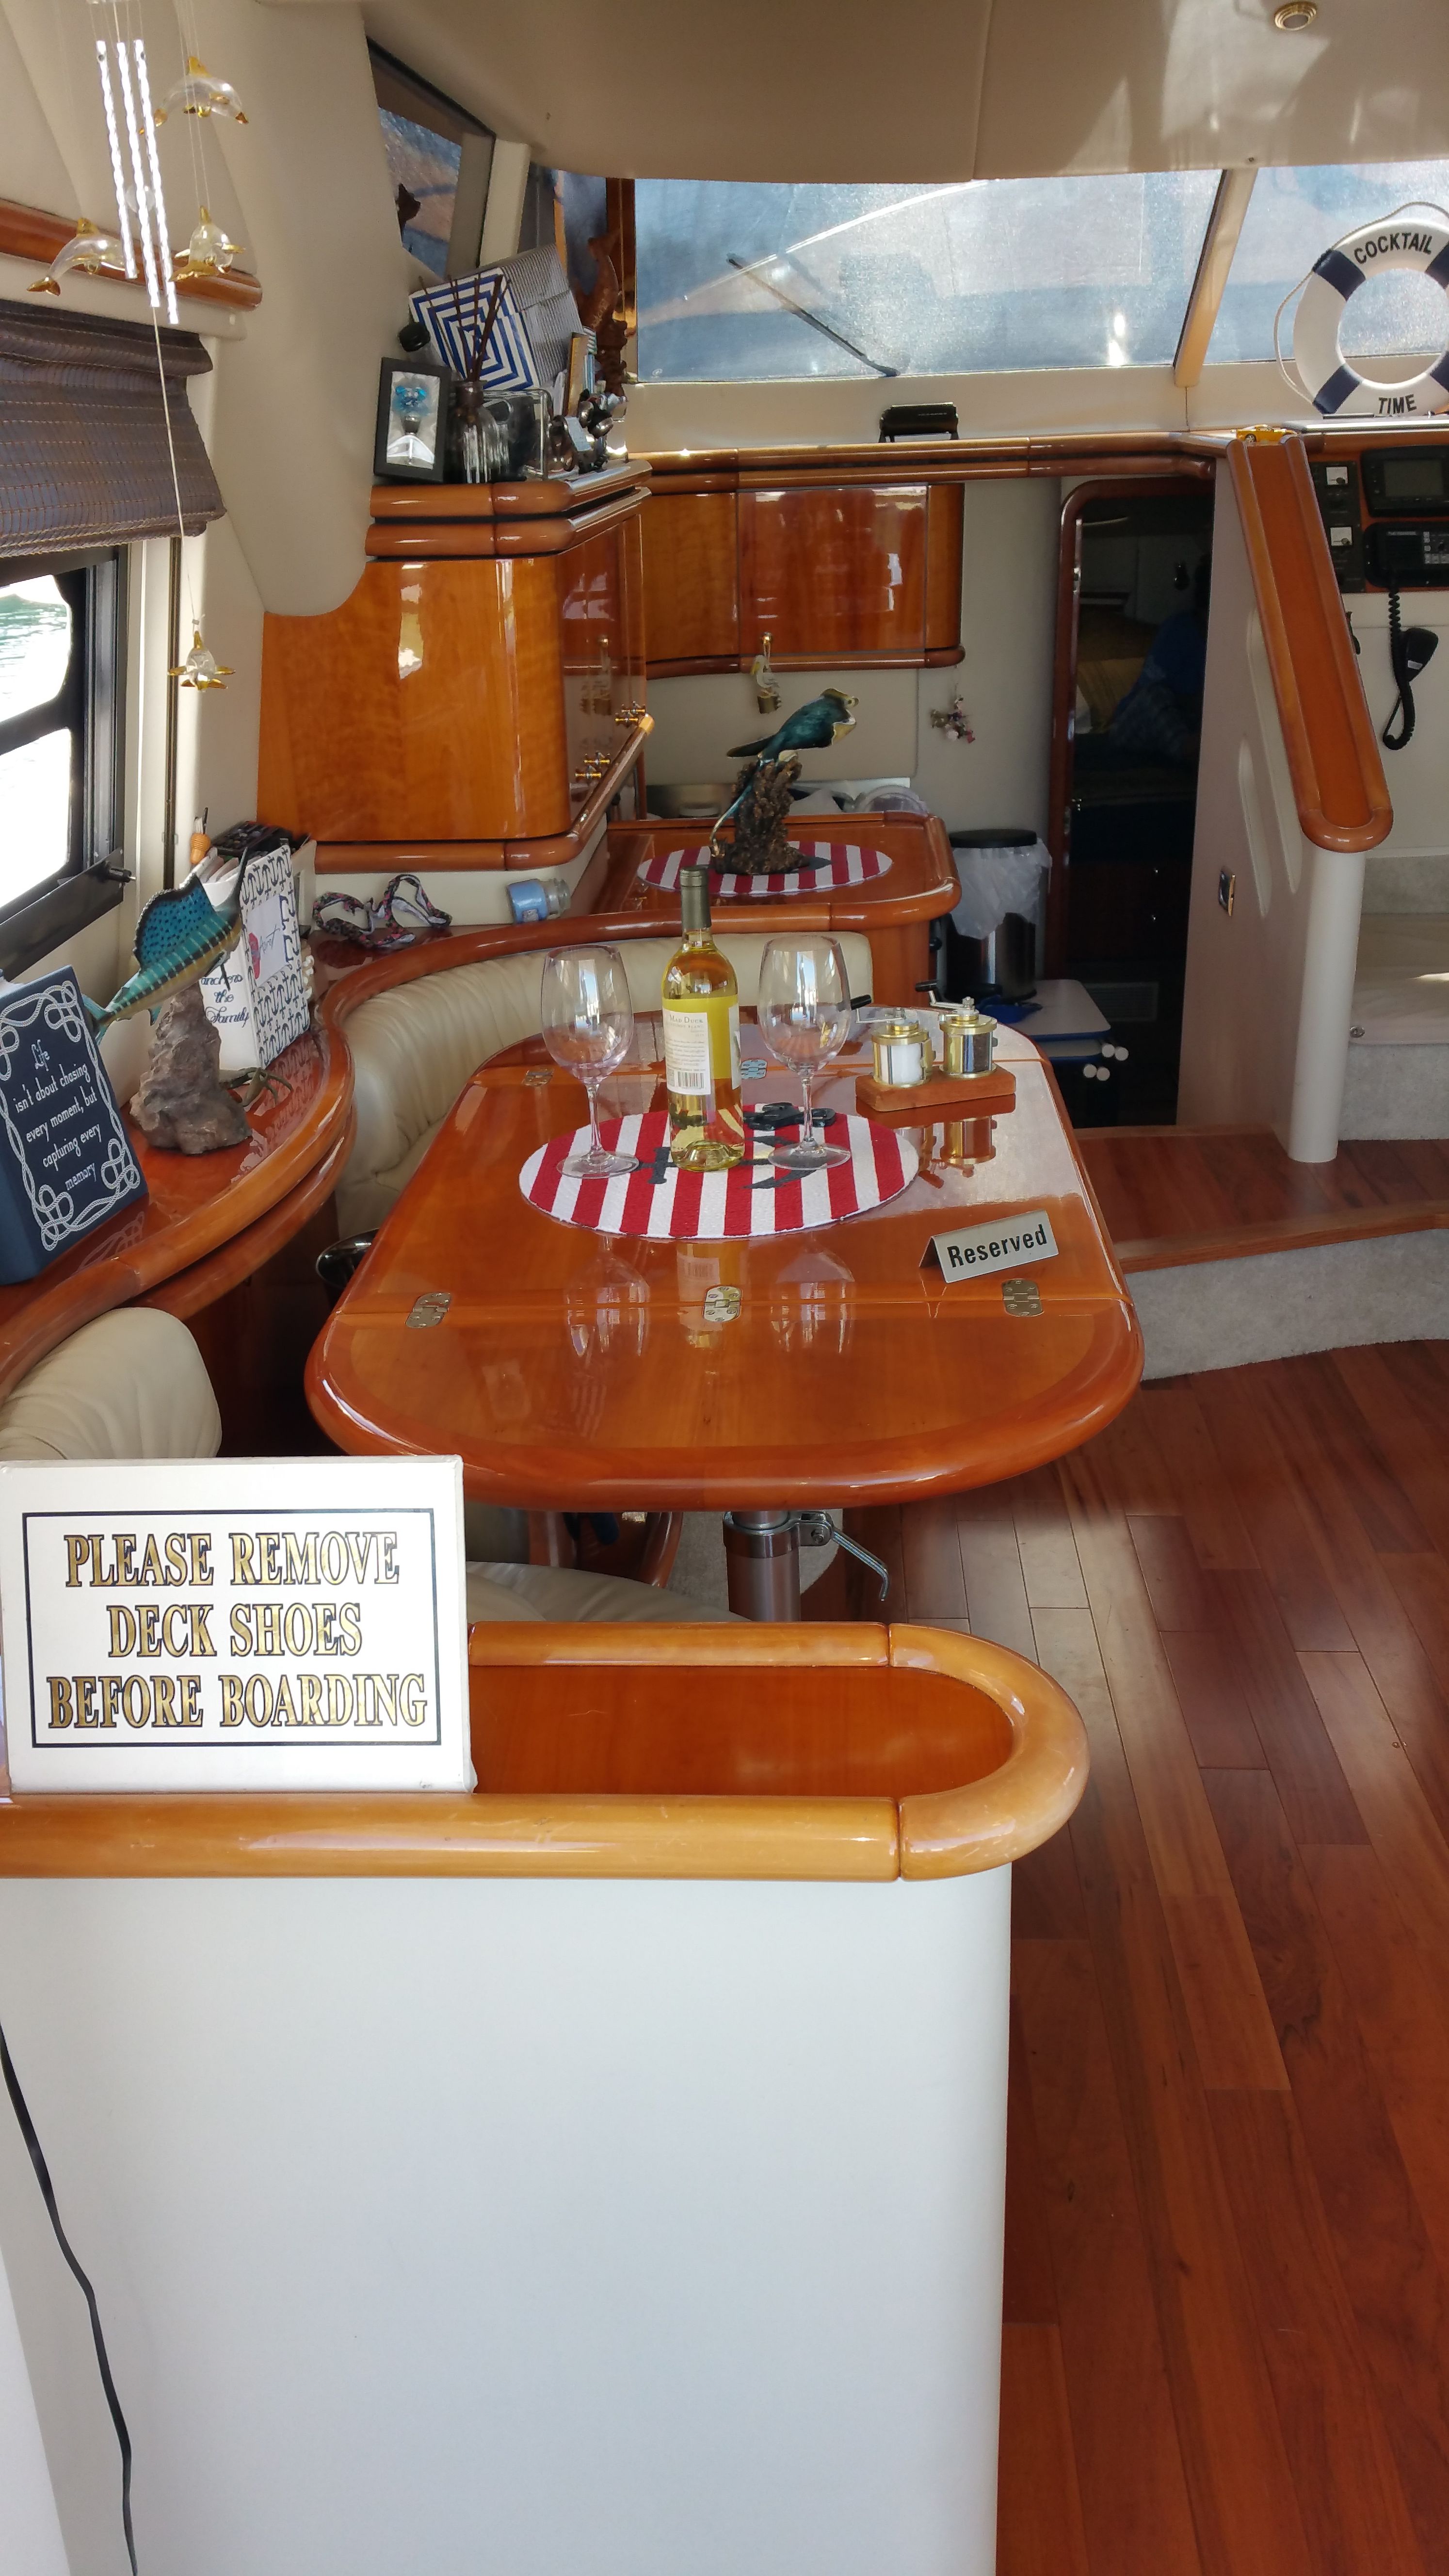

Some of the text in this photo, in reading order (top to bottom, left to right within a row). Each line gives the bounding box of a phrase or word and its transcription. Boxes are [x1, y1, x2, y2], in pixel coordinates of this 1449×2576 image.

[1354, 232, 1433, 265] COCKTAIL
[1378, 394, 1417, 414] TIME
[214, 989, 234, 1003] the
[31, 1039, 50, 1072] Life
[13, 1063, 91, 1113] isn't about chasing
[26, 1086, 97, 1143] every moment, but
[43, 1124, 102, 1172] capturing every
[65, 1163, 97, 1191] memory
[947, 1224, 1047, 1268] Reserved
[64, 1531, 400, 1588] PLEASE REMOVE
[107, 1602, 363, 1658] DECK SHOES
[47, 1673, 428, 1729] BEFORE BOARDING
